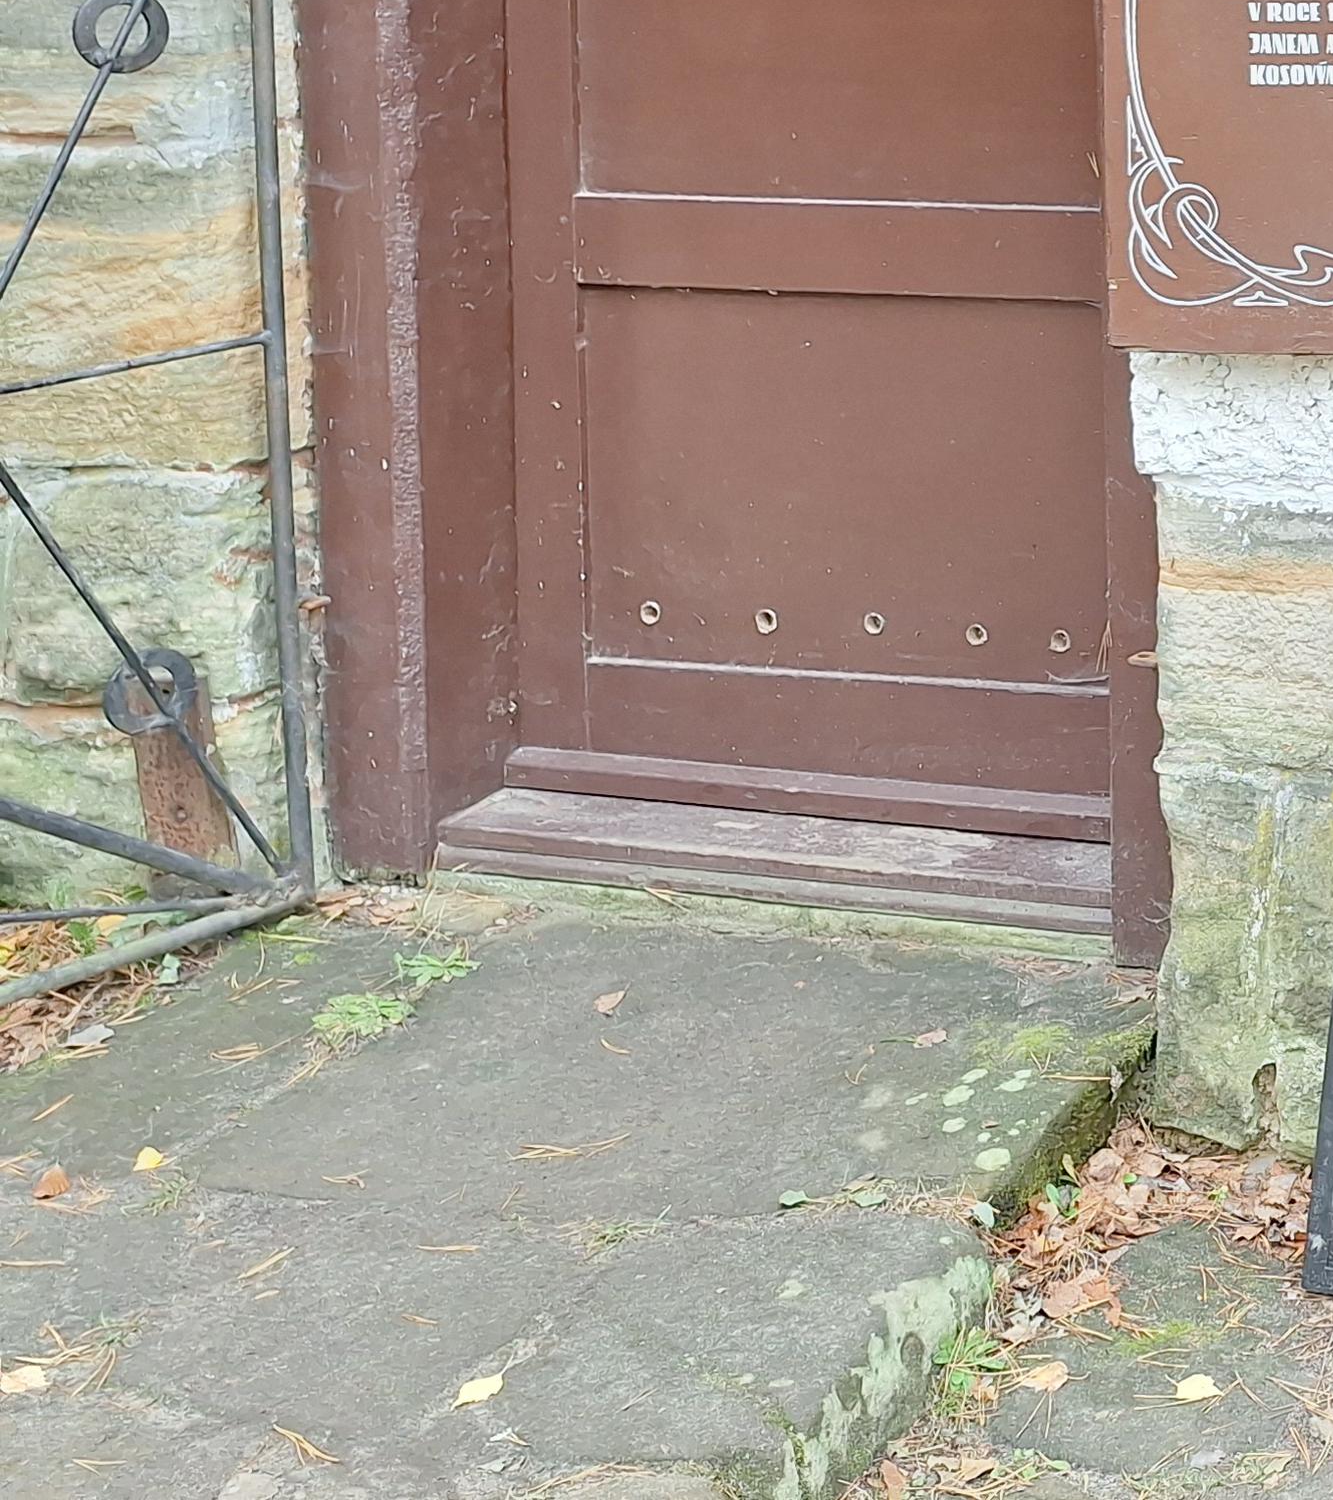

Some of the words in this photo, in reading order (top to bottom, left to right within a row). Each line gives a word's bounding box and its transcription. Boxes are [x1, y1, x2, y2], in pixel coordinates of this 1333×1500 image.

[1248, 2, 1261, 22] V
[1266, 2, 1321, 22] ROCE
[1247, 33, 1319, 55] JANEM
